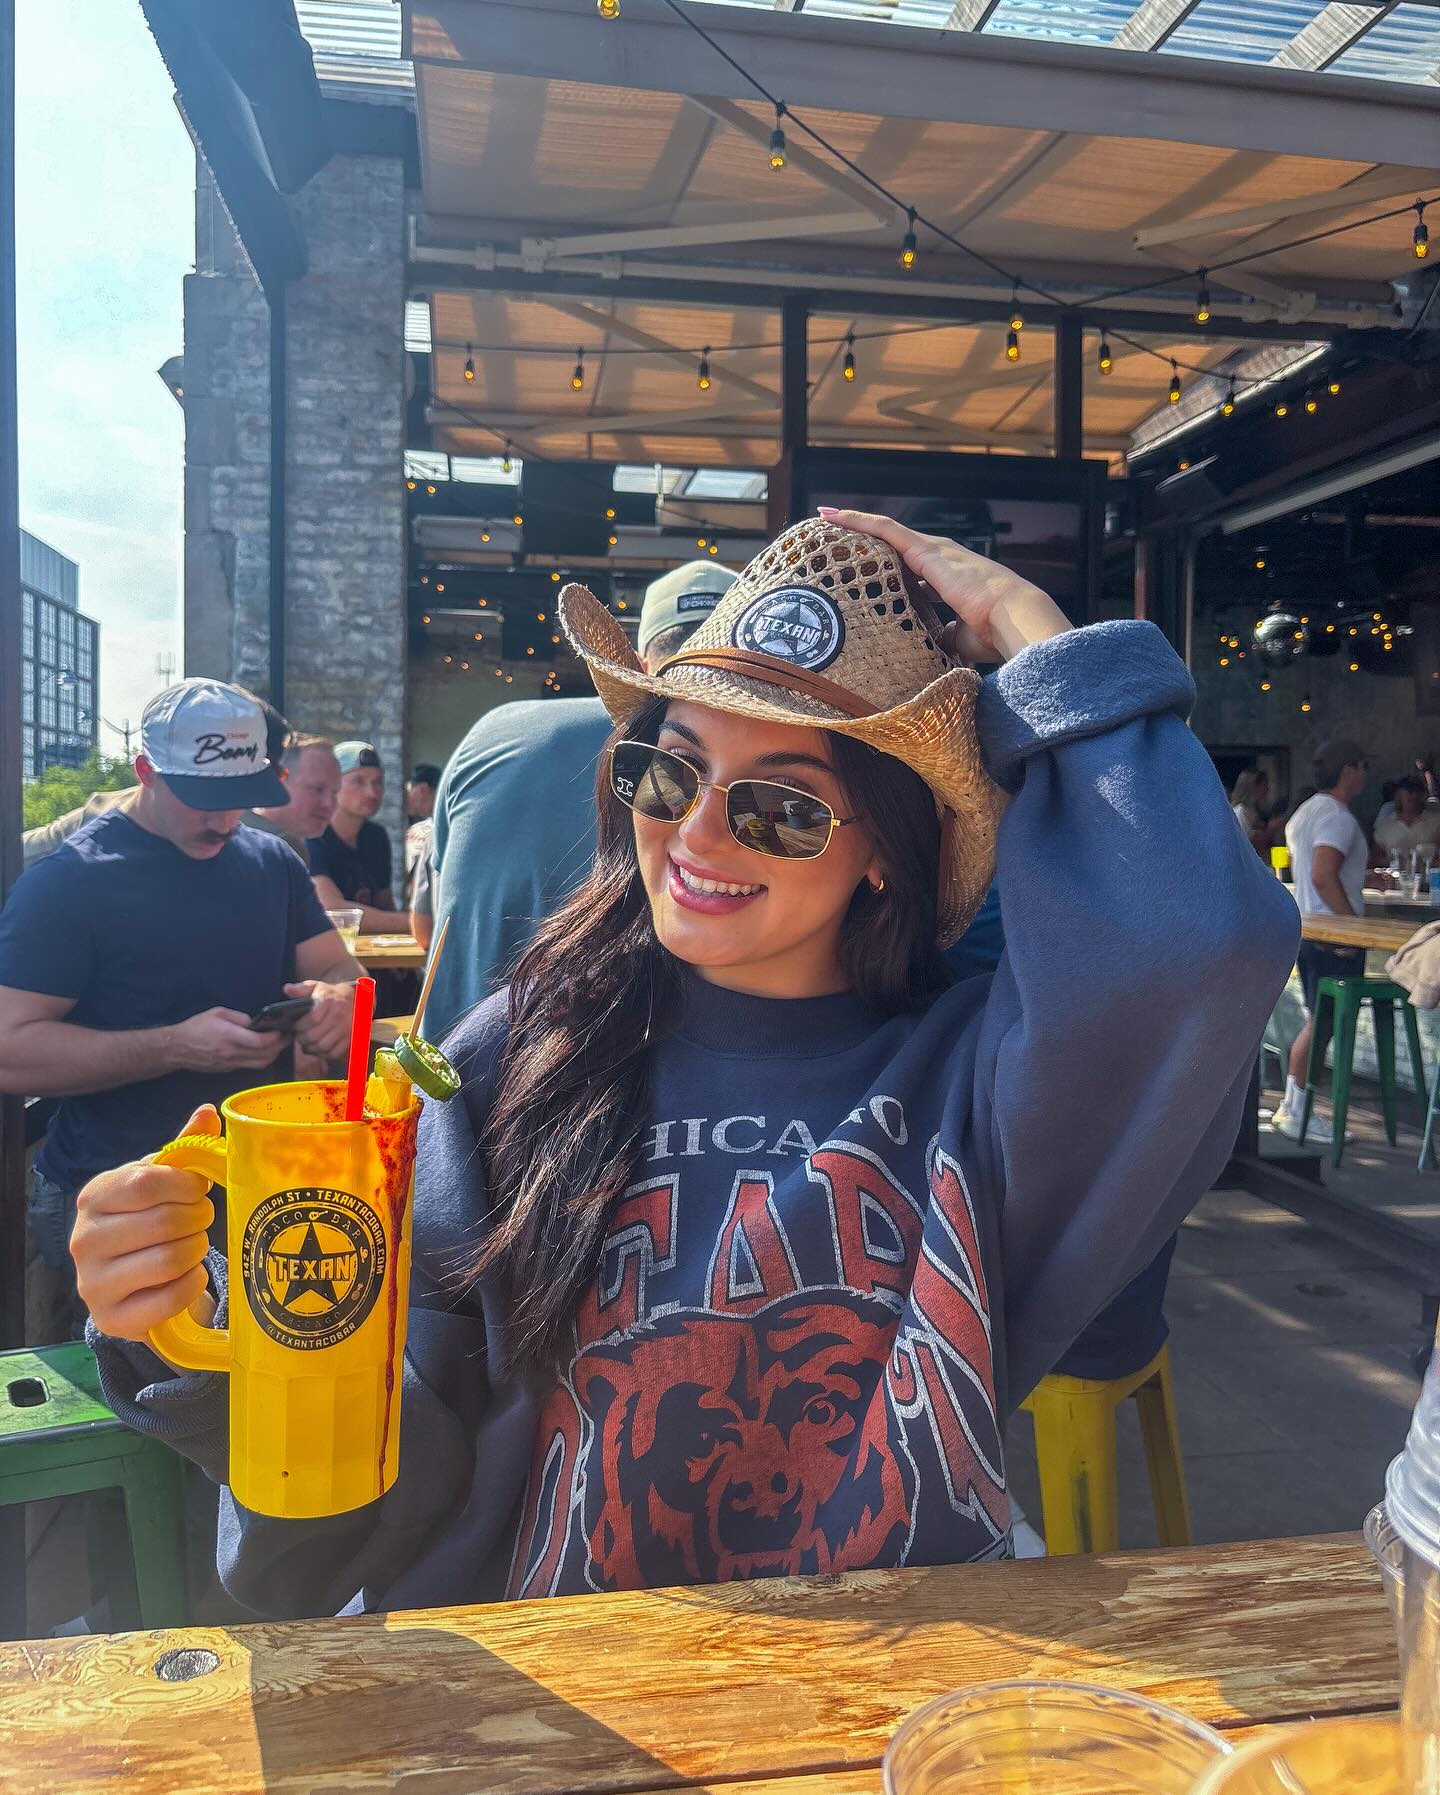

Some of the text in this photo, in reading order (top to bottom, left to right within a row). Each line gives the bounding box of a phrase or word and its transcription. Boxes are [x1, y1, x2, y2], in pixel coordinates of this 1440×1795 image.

[762, 617, 815, 645] TEXAN
[641, 1094, 908, 1162] HICAO
[243, 1254, 251, 1278] 942
[248, 1196, 284, 1234] RANDOLPH
[262, 1211, 361, 1240] TACO BAR
[316, 1190, 386, 1275] TEXANTACOBAR.COM
[275, 1254, 350, 1281] TEXAN
[267, 1322, 356, 1349] @TEXANTACOBAR
